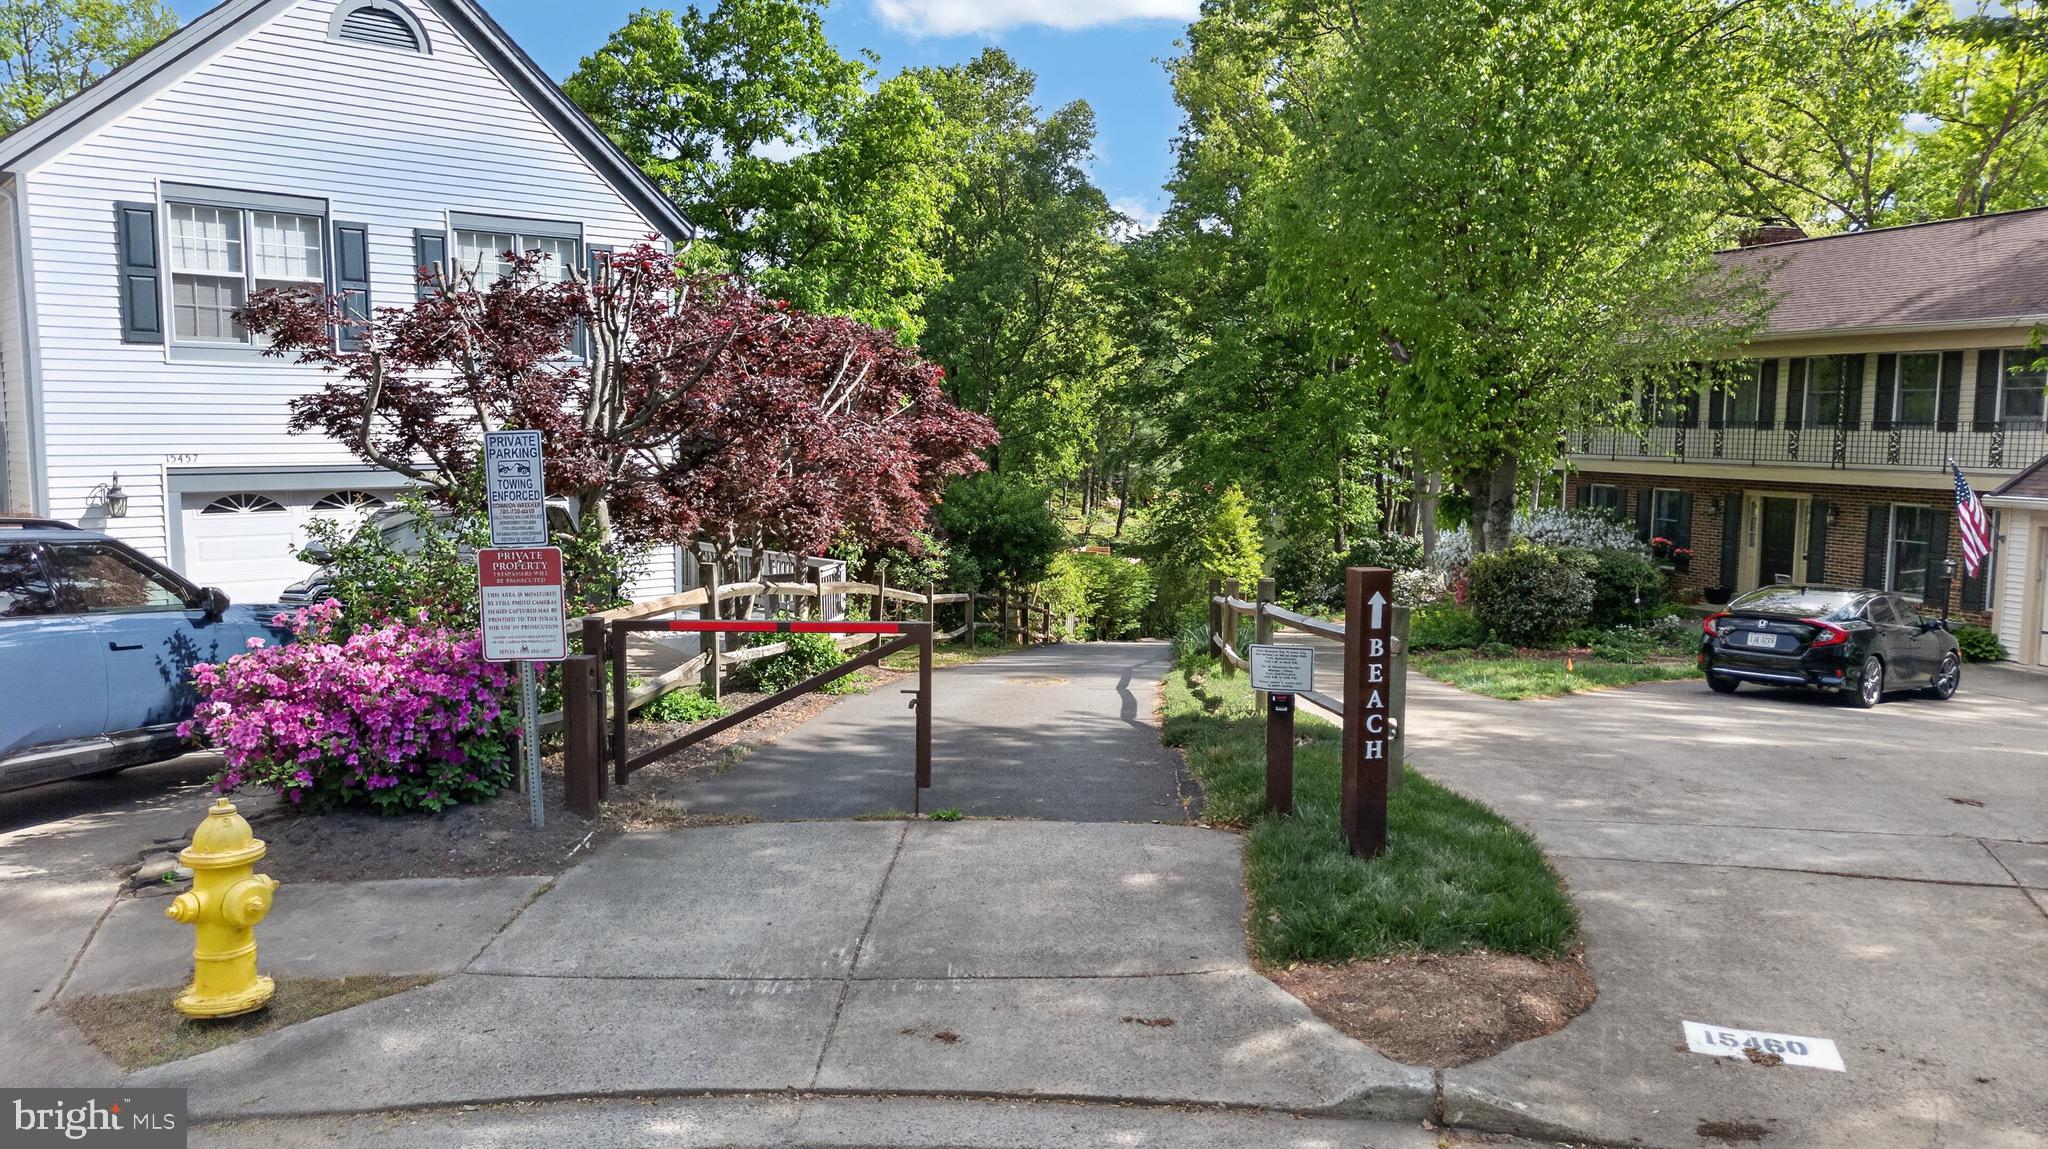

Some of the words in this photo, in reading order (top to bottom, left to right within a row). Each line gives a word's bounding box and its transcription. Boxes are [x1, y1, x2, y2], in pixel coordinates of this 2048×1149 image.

[489, 435, 536, 447] PRIVATE
[166, 453, 198, 463] 15457
[489, 447, 537, 459] PARKING
[498, 479, 533, 489] TOWING
[492, 491, 540, 502] ENFORCED
[497, 551, 543, 560] PRIVATE
[492, 561, 547, 570] PROPERTY
[1364, 638, 1384, 760] BEACH
[1704, 1030, 1809, 1056] 15460
